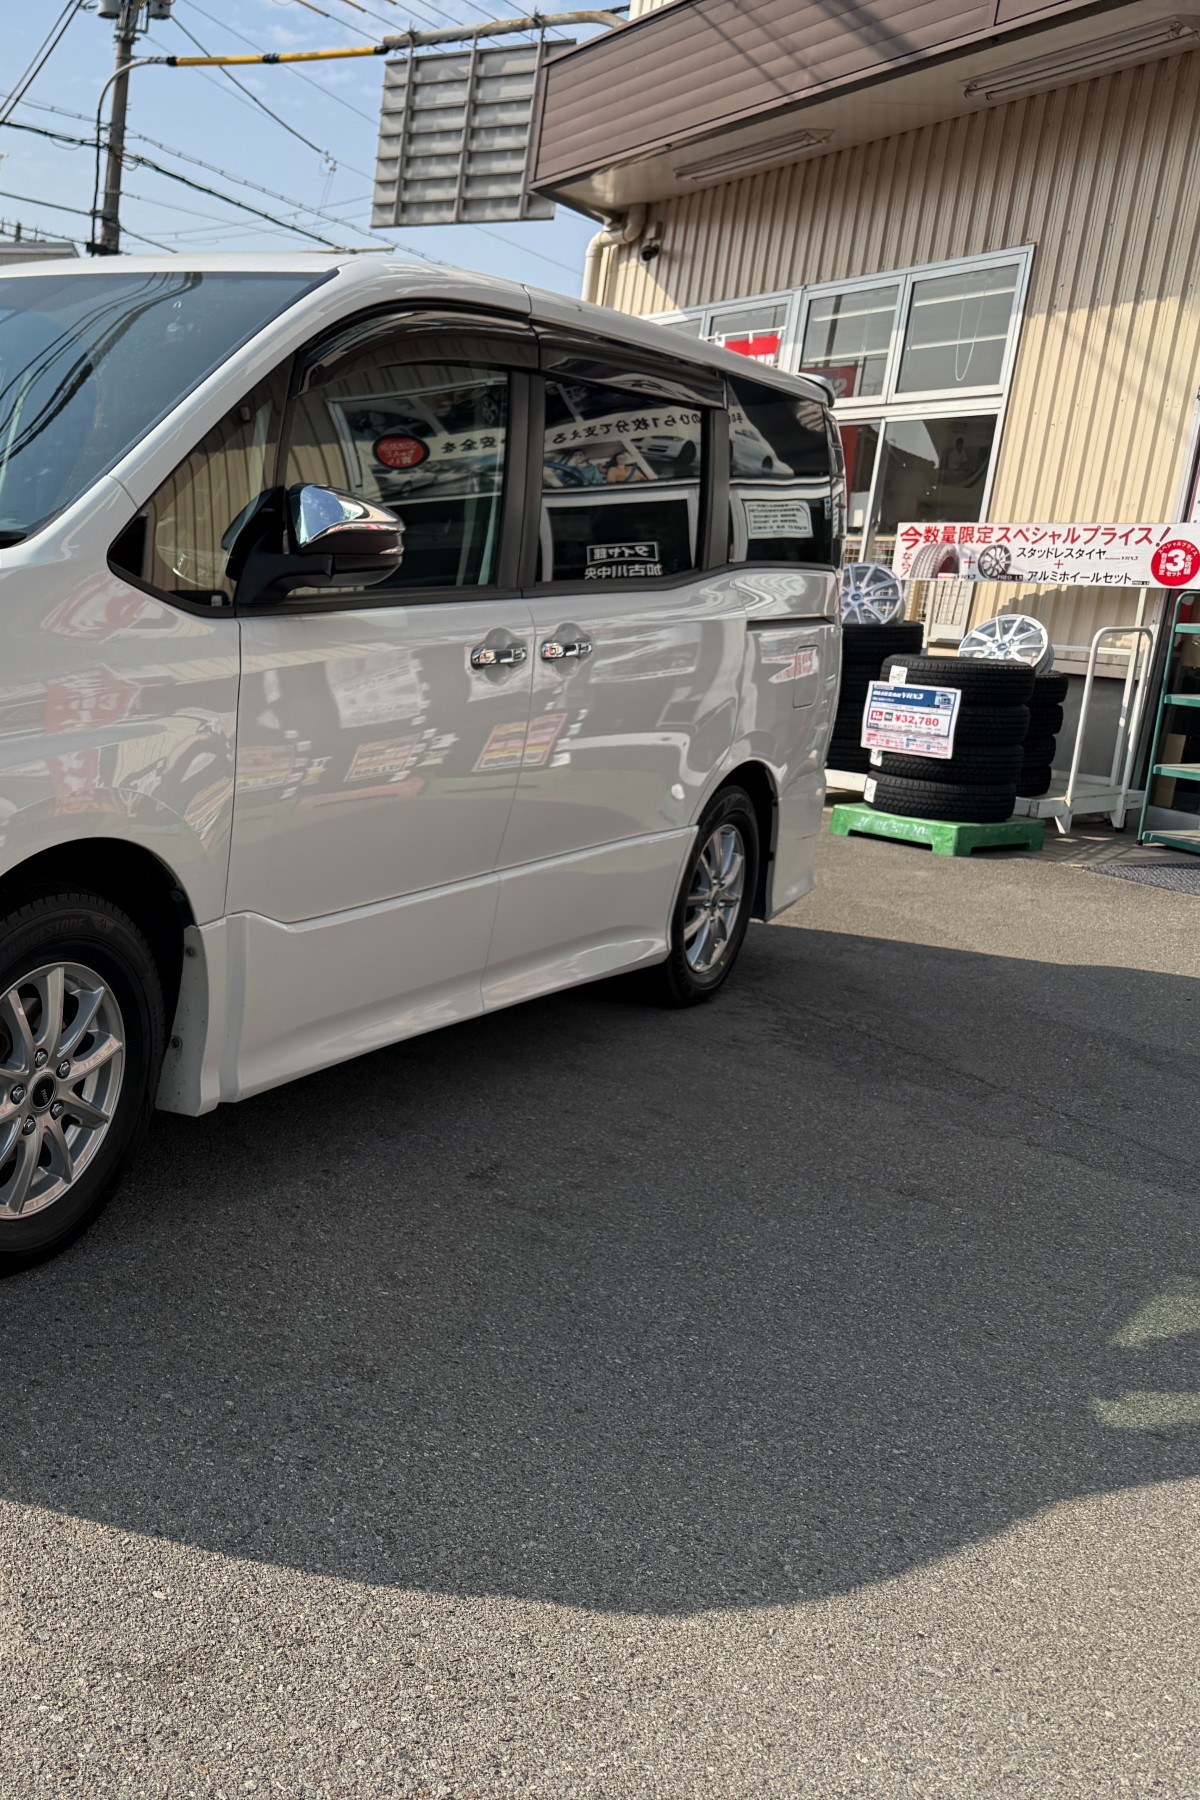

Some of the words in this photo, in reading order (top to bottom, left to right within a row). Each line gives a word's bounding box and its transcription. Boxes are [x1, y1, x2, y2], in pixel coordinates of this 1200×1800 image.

[1016, 547, 1107, 559] スタッドレスタイヤ
[1165, 548, 1186, 571] 3
[1027, 570, 1132, 584] アルミホイールセット
[895, 713, 939, 727] ¥32,780
